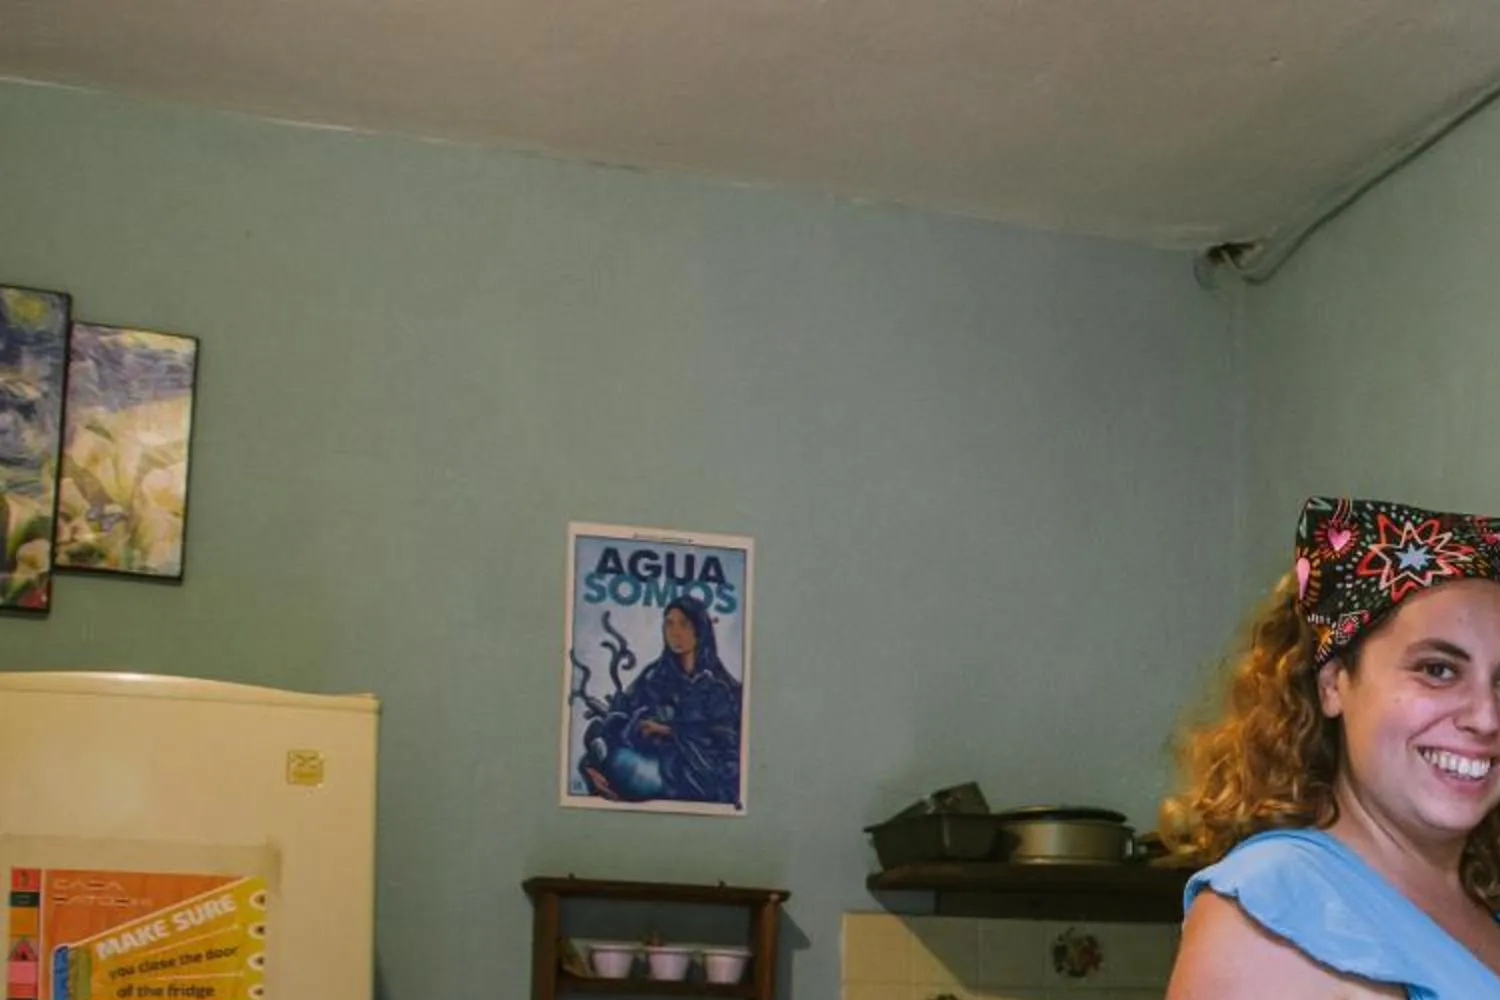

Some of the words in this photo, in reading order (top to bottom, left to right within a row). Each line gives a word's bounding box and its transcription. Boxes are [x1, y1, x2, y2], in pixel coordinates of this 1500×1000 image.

[596, 546, 726, 585] AGUA
[583, 572, 738, 615] SOMOS
[96, 919, 171, 960] MAKE
[170, 894, 237, 932] SURE
[108, 965, 135, 981] you
[138, 958, 176, 973] close
[178, 952, 203, 964] the
[205, 945, 239, 960] door
[116, 984, 134, 998] of
[136, 984, 163, 997] the
[167, 984, 215, 999] fridge
